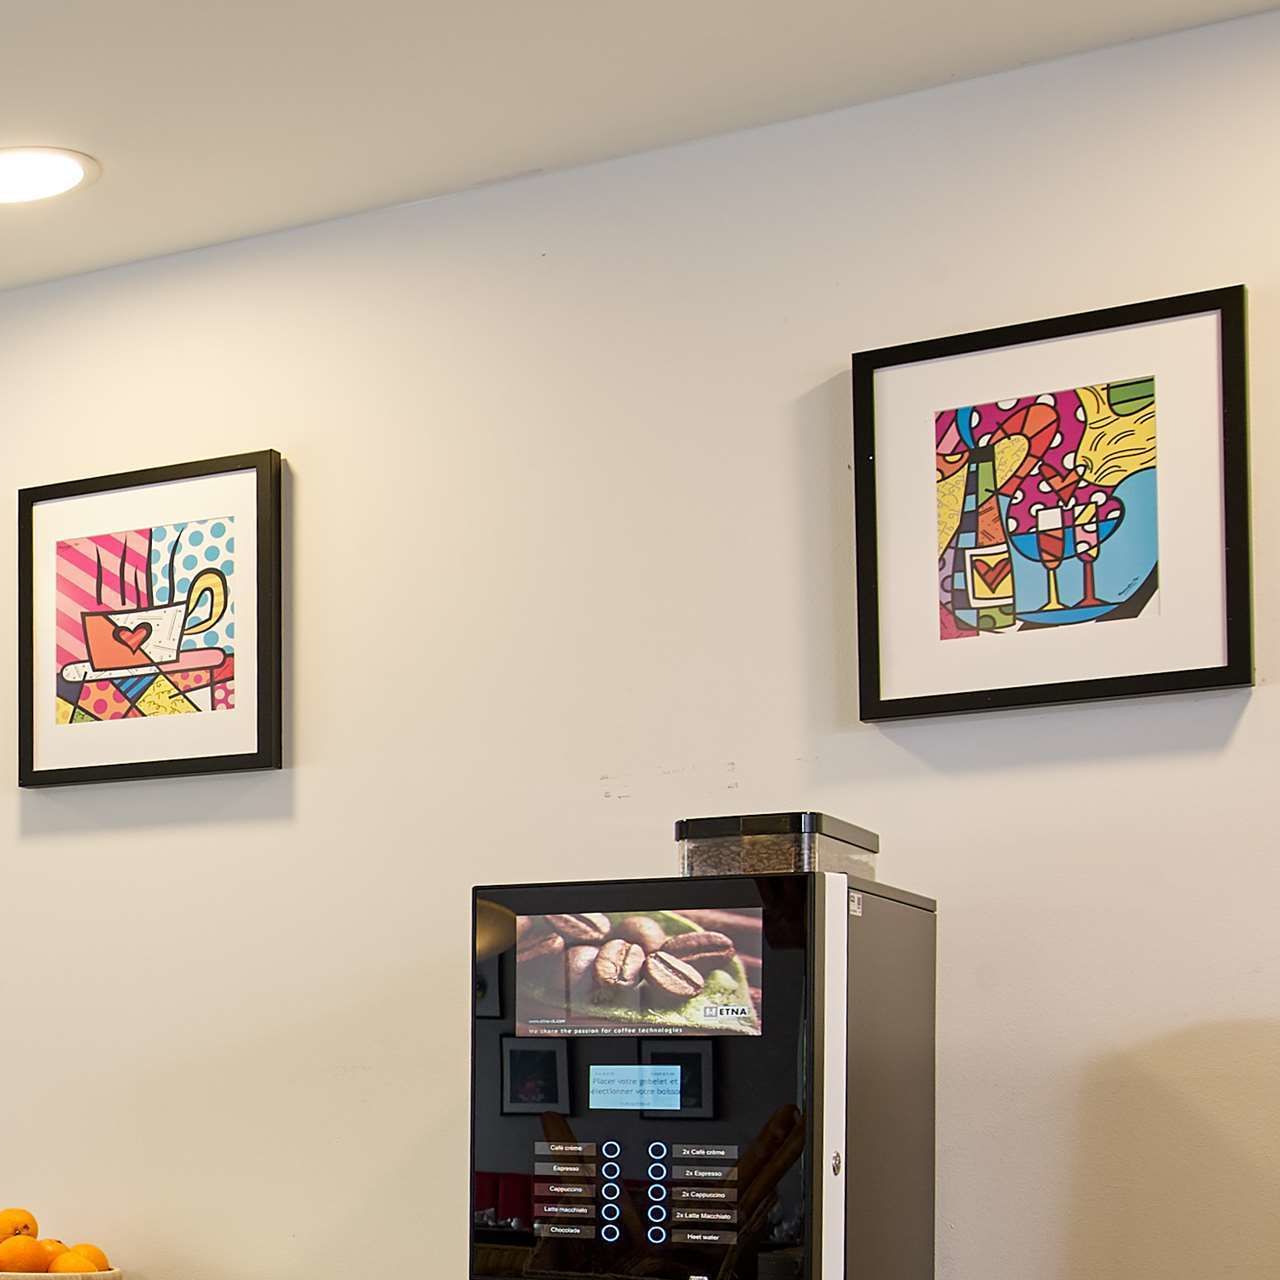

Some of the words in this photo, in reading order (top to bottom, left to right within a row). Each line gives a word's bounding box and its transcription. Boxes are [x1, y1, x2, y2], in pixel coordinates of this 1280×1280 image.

[719, 1006, 748, 1016] ETNA
[638, 1027, 683, 1035] technologies
[549, 1185, 583, 1193] Cappuccino
[690, 1191, 726, 1199] Cappuccino
